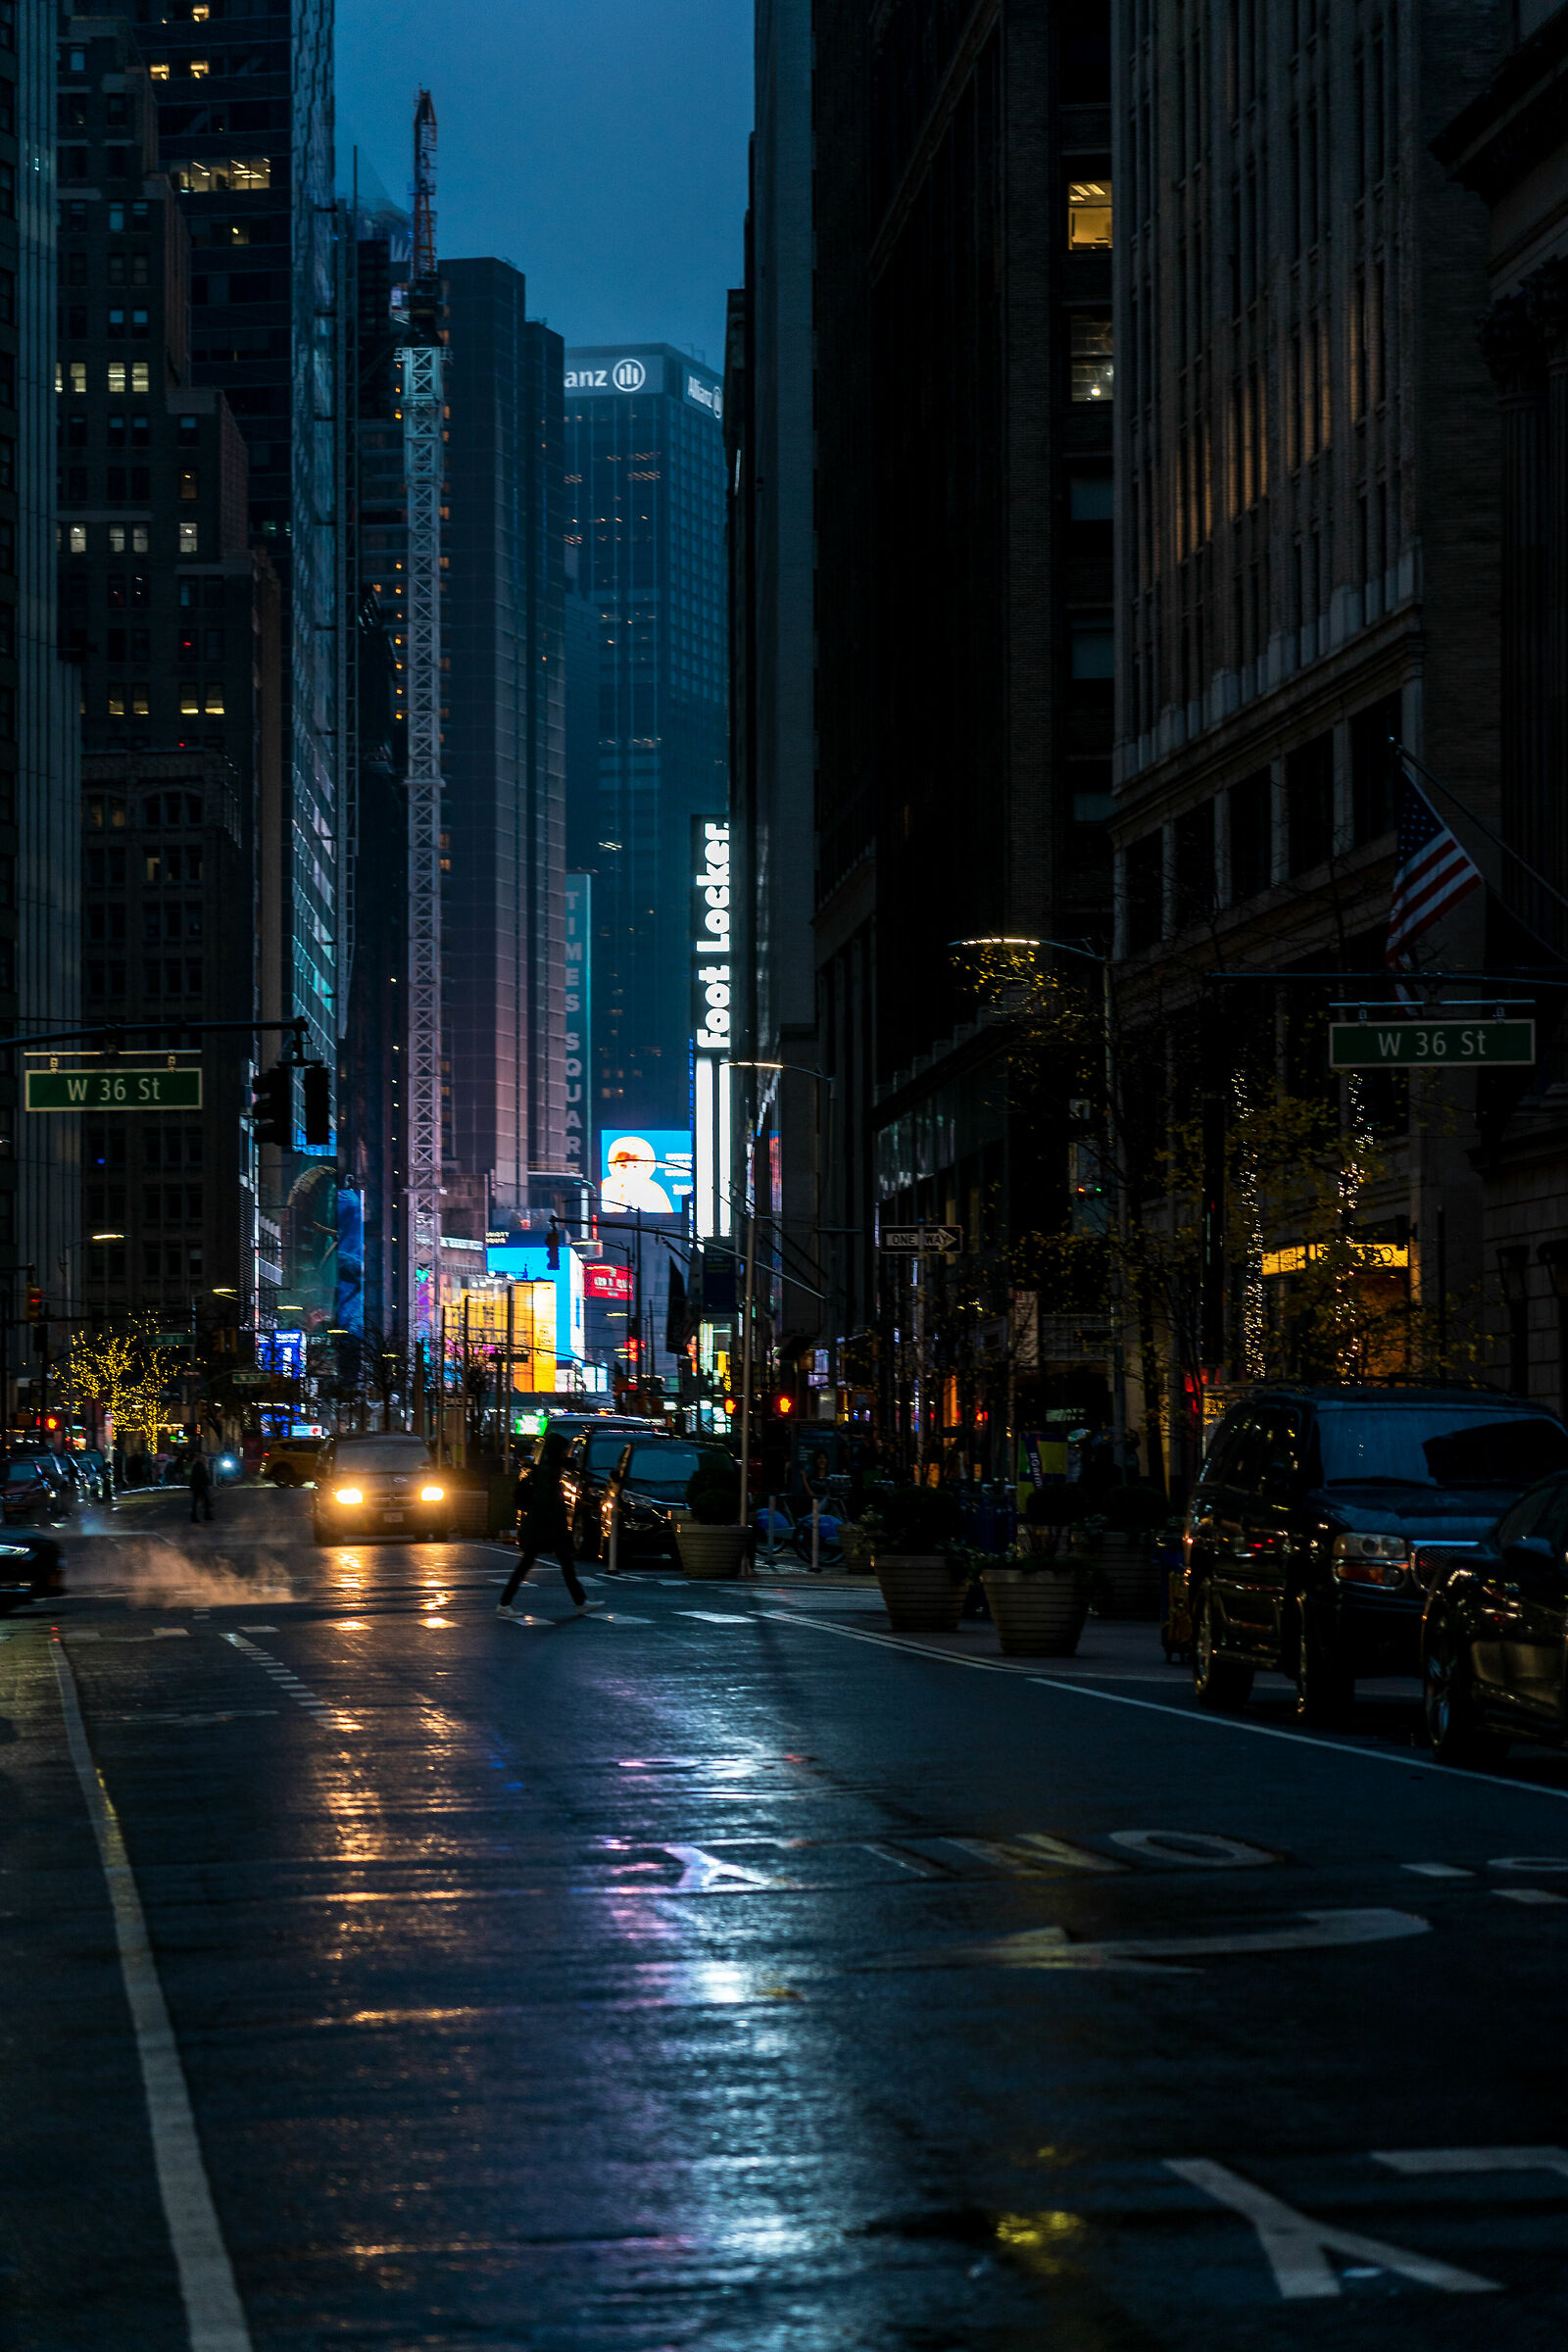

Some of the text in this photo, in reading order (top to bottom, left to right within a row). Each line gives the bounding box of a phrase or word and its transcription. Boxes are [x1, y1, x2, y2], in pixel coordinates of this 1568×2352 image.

[565, 891, 583, 1012] TIMES
[696, 964, 731, 1049] Foot
[1378, 1030, 1487, 1056] W 36 St
[67, 1078, 161, 1102] W 36 St
[892, 1235, 948, 1246] ONE WAY
